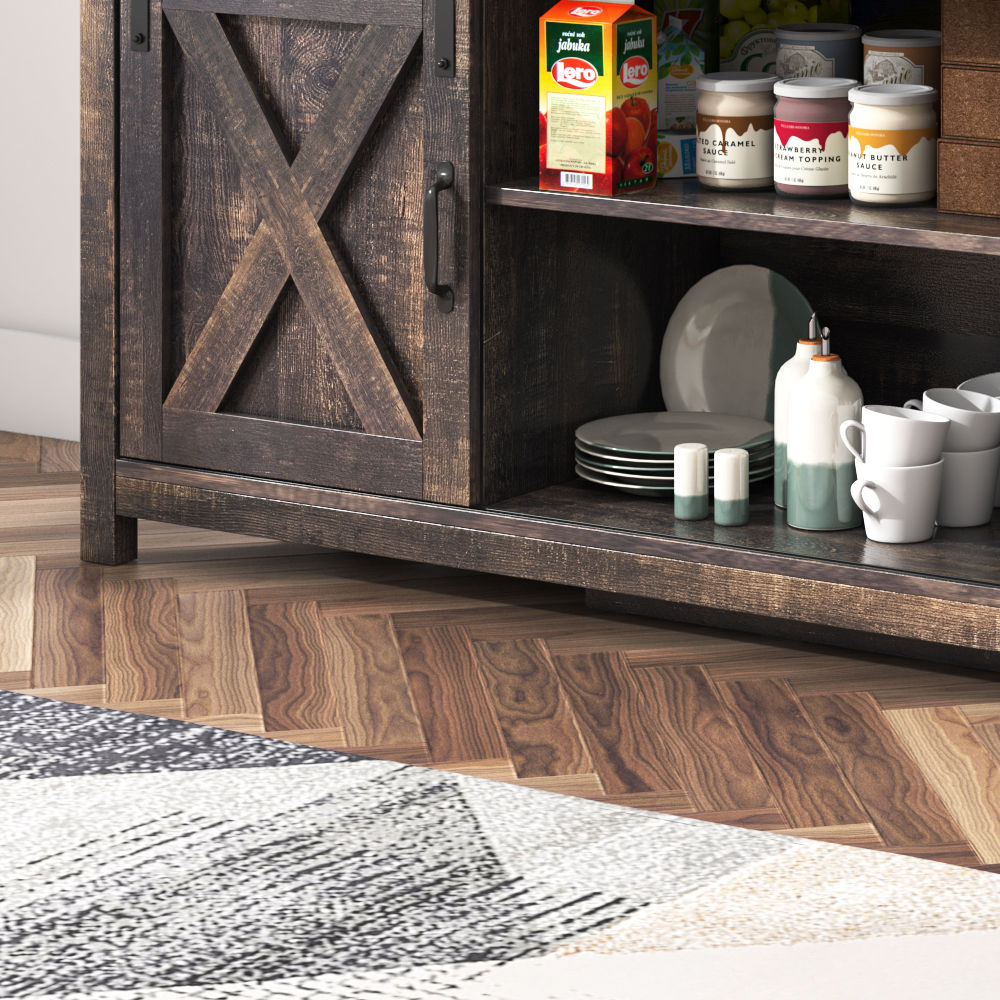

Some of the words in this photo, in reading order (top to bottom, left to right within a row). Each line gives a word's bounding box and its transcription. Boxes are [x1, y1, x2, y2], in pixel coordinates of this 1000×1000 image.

[570, 7, 601, 16] Lero
[557, 38, 590, 53] jabuka
[623, 37, 645, 55] jabuka
[556, 62, 596, 82] Lero
[623, 63, 648, 83] Lero
[703, 148, 728, 156] SAUCE
[857, 162, 883, 170] SAUCE
